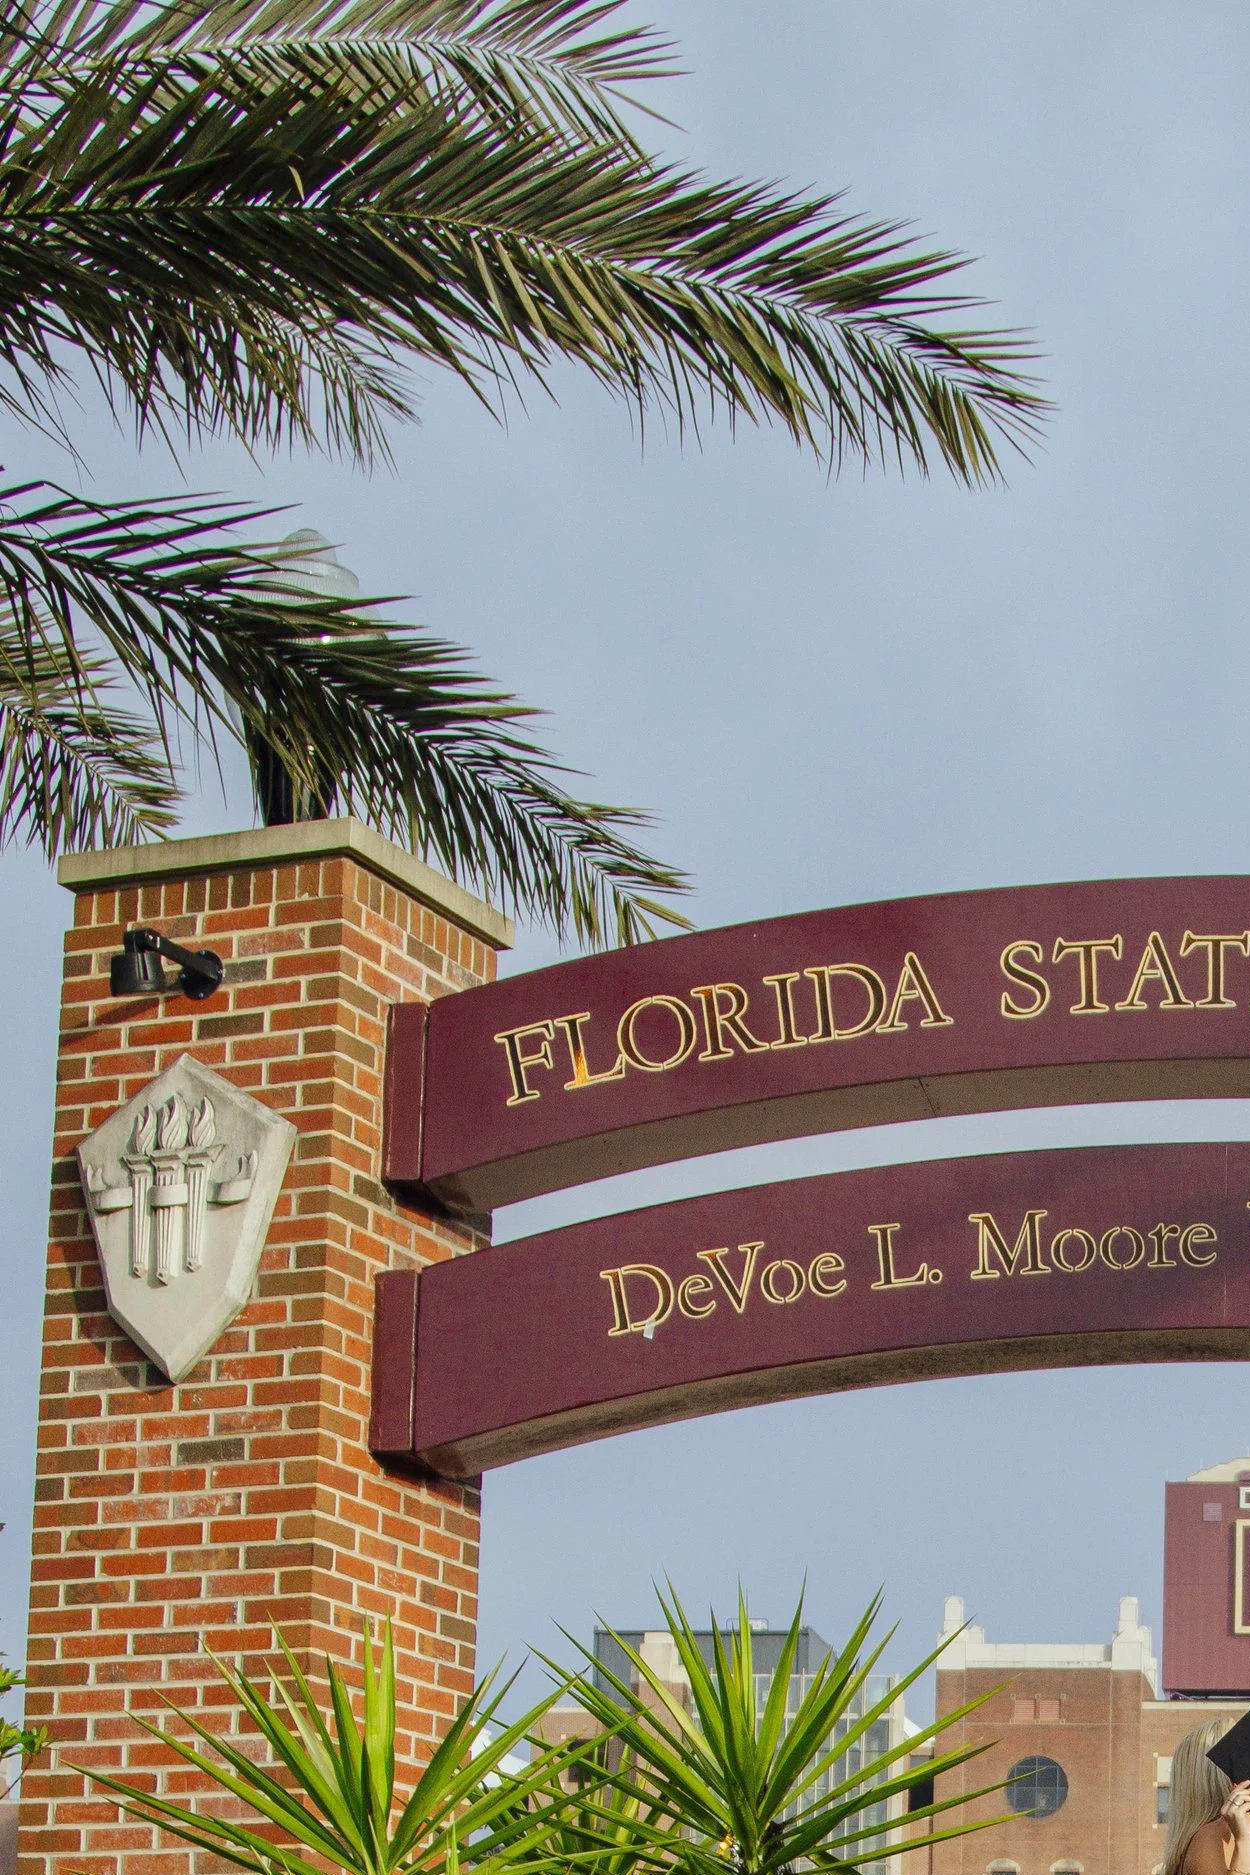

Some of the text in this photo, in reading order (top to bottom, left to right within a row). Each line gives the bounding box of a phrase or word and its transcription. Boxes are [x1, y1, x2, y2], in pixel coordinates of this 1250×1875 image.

[493, 952, 955, 1108] FLORIDA
[601, 1241, 847, 1338] DeVoe
[868, 1222, 943, 1291] L.
[969, 1210, 1218, 1280] Moore
